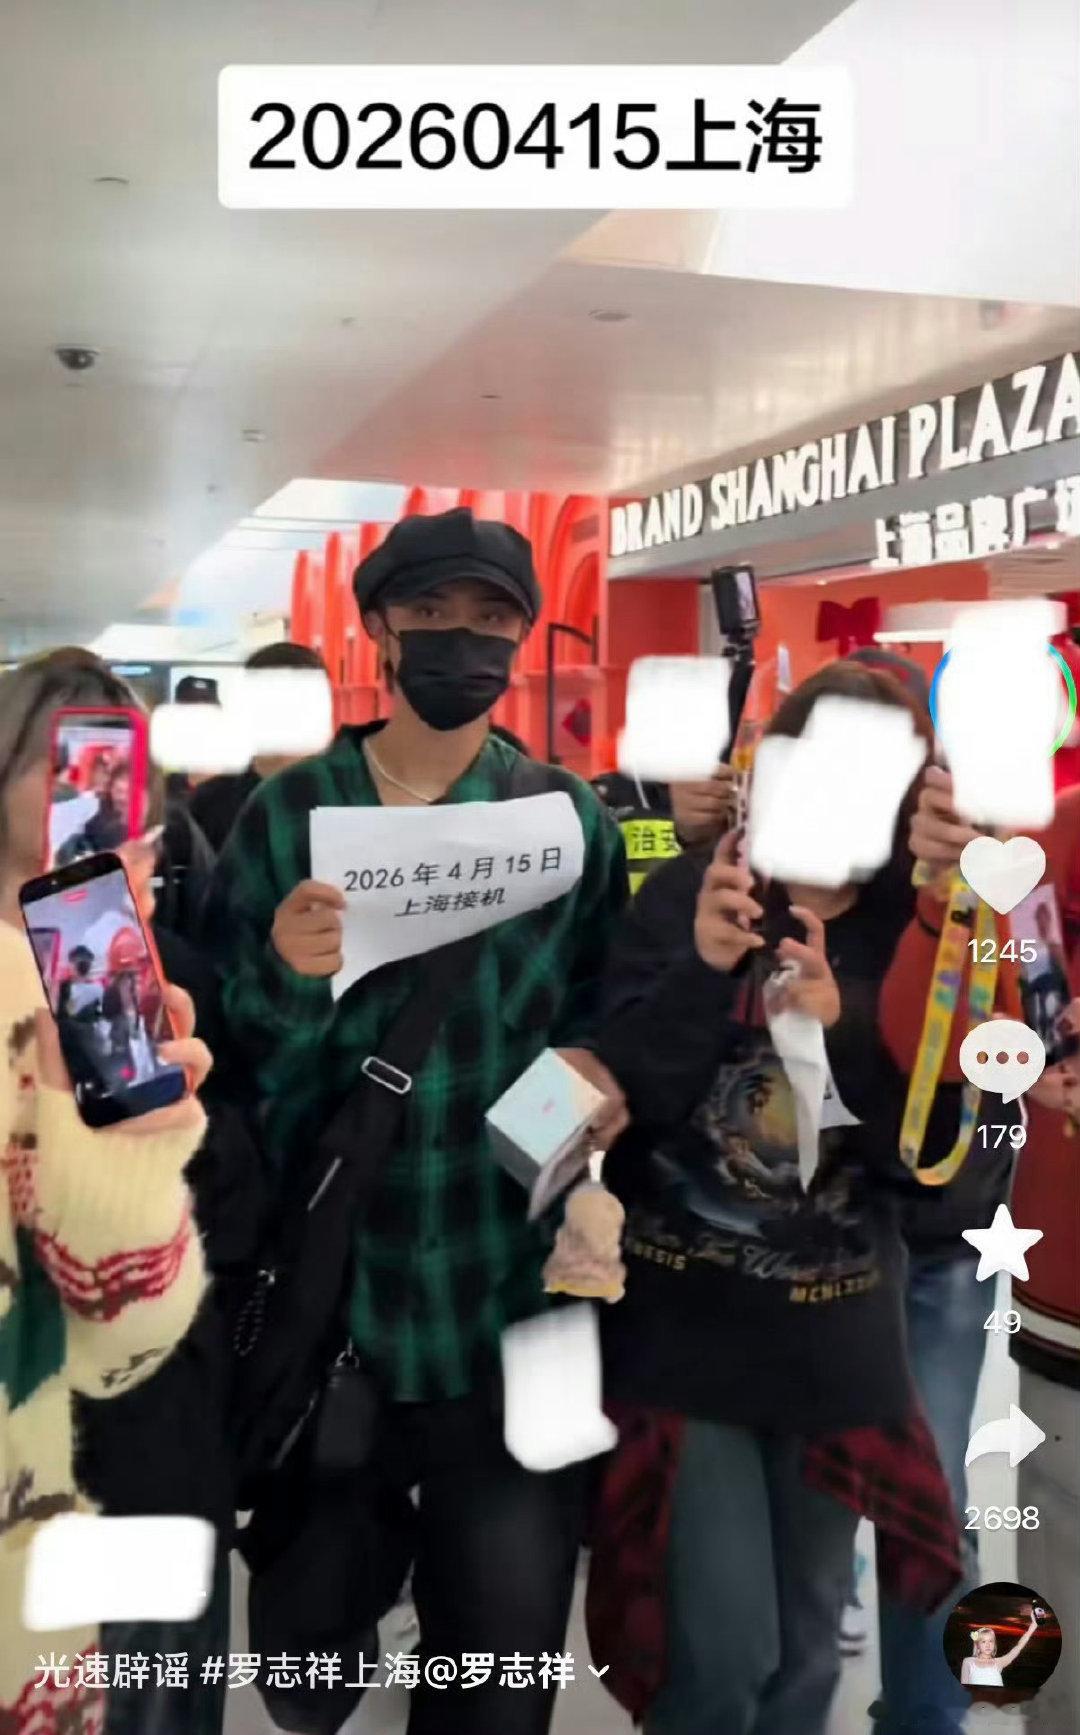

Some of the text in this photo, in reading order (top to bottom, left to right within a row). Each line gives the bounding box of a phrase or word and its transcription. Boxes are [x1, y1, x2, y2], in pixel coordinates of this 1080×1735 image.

[610, 352, 1080, 557] BRAND SHANGHAI PLAZA
[344, 846, 562, 892] 2026 年 4 月 15 日
[394, 887, 506, 917] 上海接机
